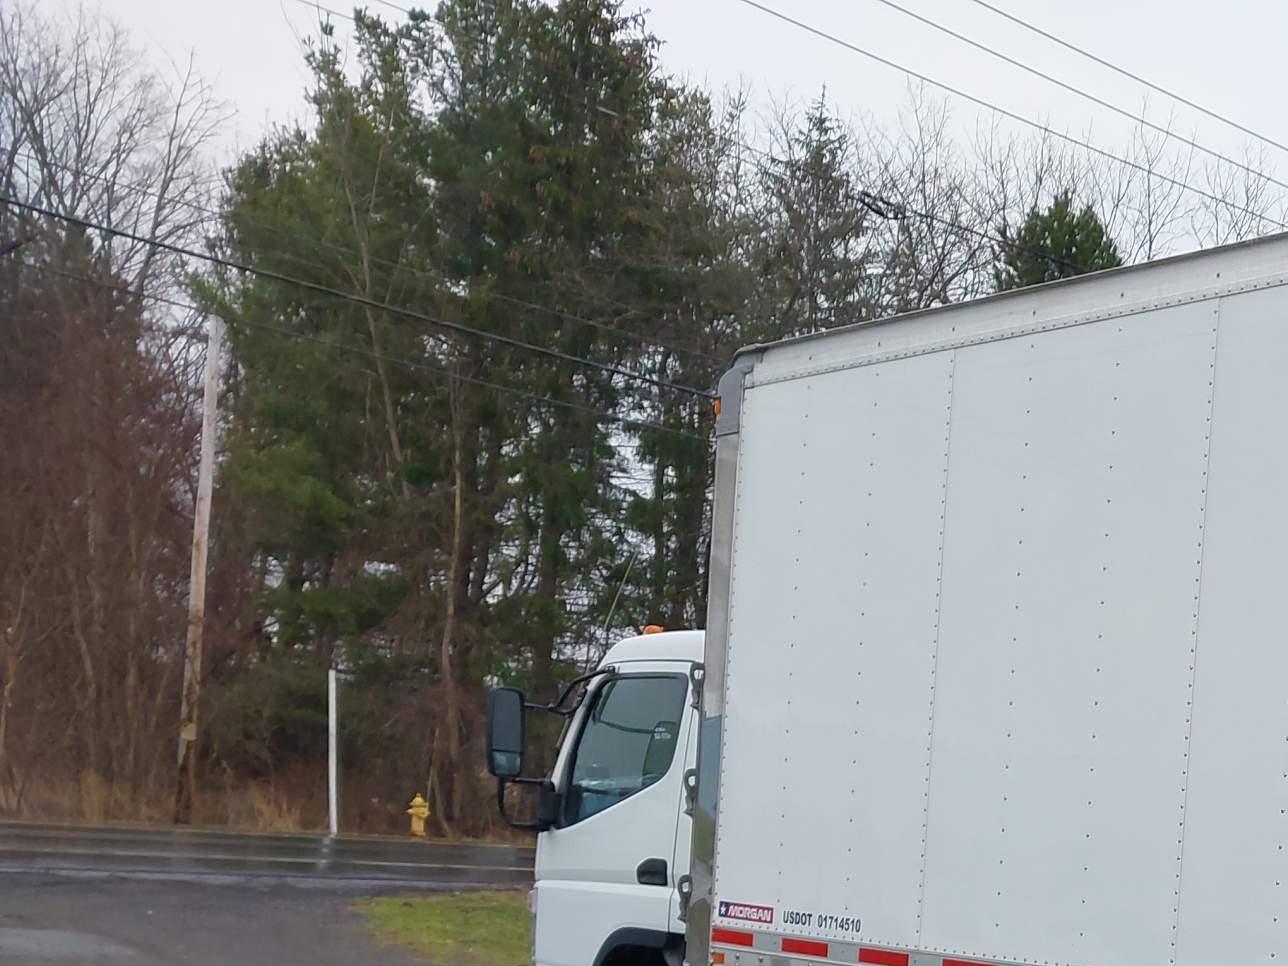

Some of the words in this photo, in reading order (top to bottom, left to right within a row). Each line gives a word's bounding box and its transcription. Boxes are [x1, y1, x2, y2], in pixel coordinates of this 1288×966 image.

[727, 904, 773, 923] MORGAN
[783, 910, 813, 928] USDOT
[817, 916, 861, 933] 01714510
